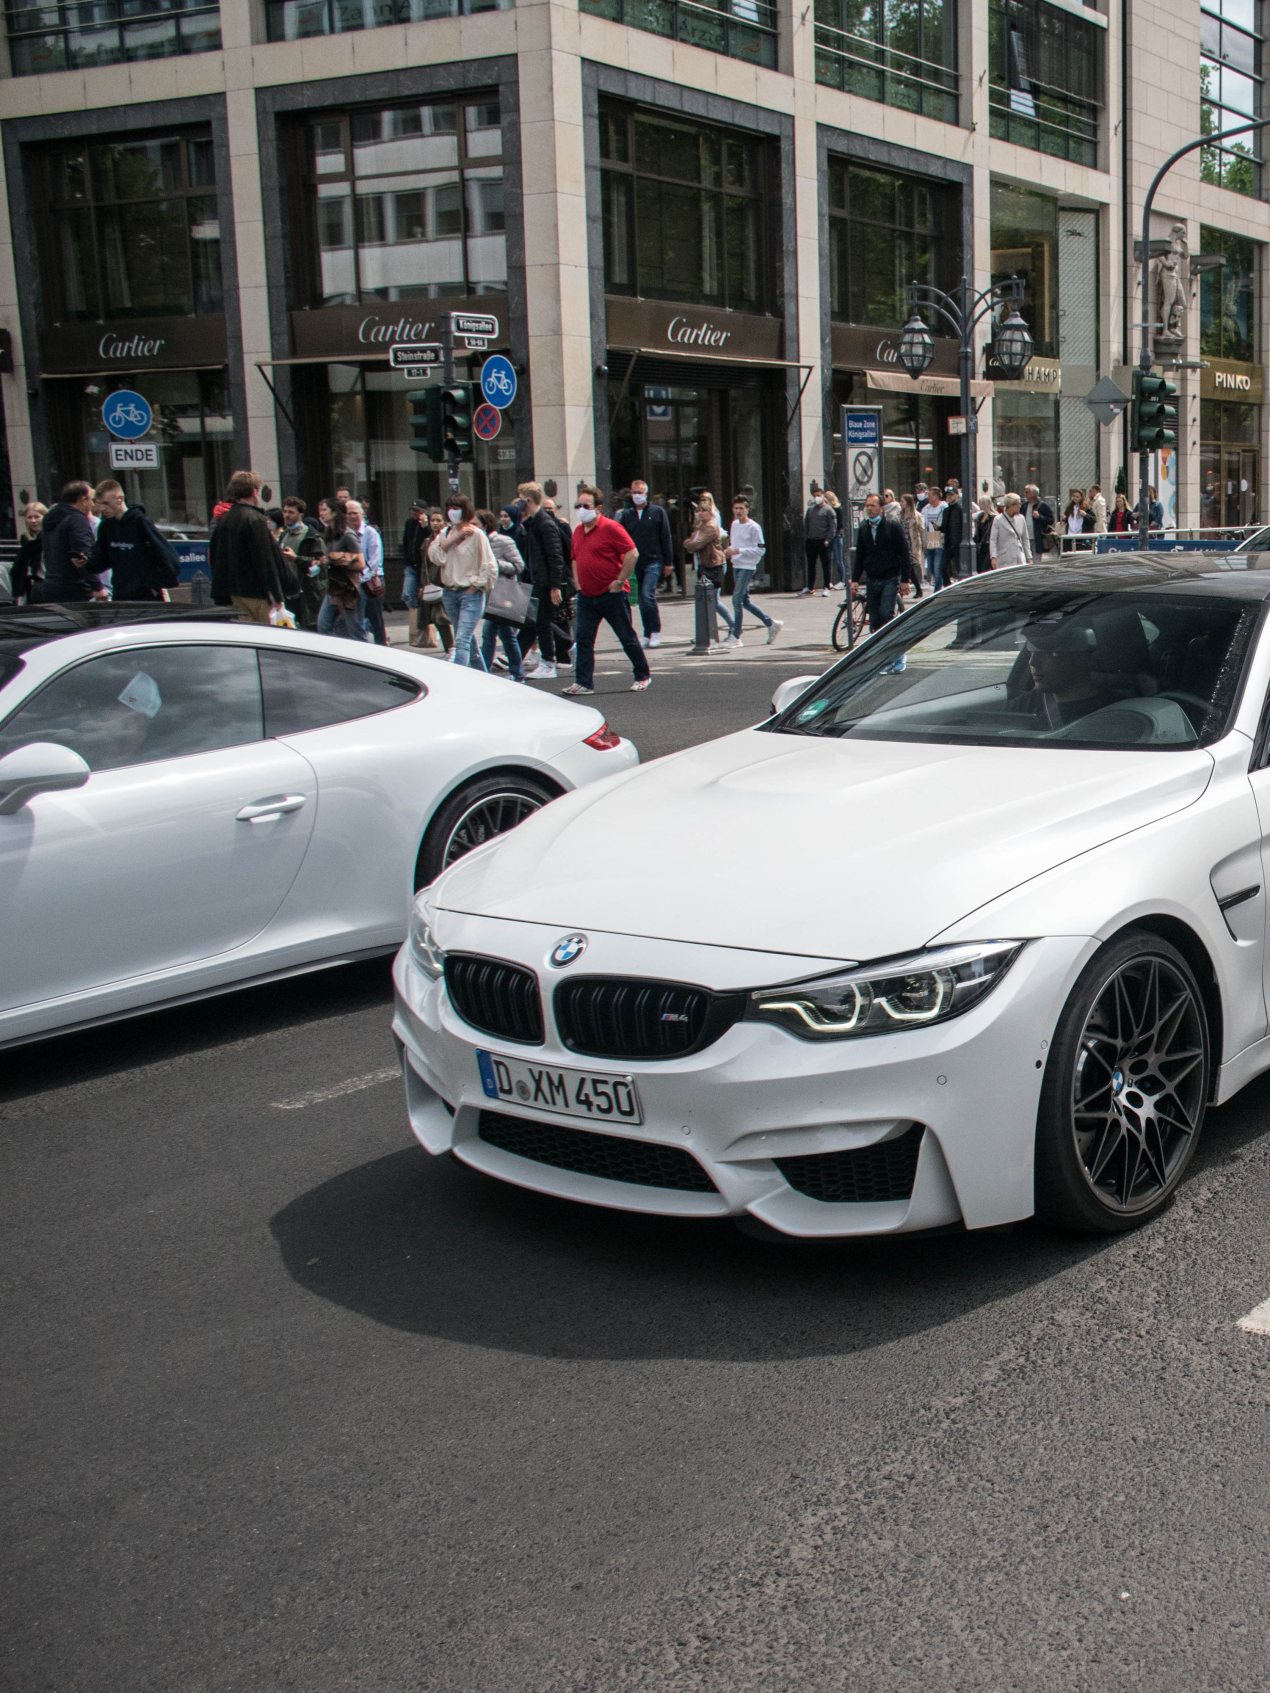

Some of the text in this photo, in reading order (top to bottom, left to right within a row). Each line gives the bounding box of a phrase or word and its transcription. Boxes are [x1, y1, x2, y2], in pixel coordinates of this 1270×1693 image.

[358, 316, 436, 343] Cartier
[668, 317, 731, 346] Cartier
[99, 333, 165, 358] Cartier
[397, 350, 436, 361] Steinstraße
[1026, 366, 1058, 383] HAMP
[1215, 372, 1251, 391] PINKO
[920, 379, 945, 394] Cartier
[848, 420, 876, 429] Blaue Zone
[848, 430, 877, 440] Königsallee
[115, 449, 154, 462] ENDE
[179, 552, 206, 563] sallee
[493, 1059, 635, 1117] D XM 450
